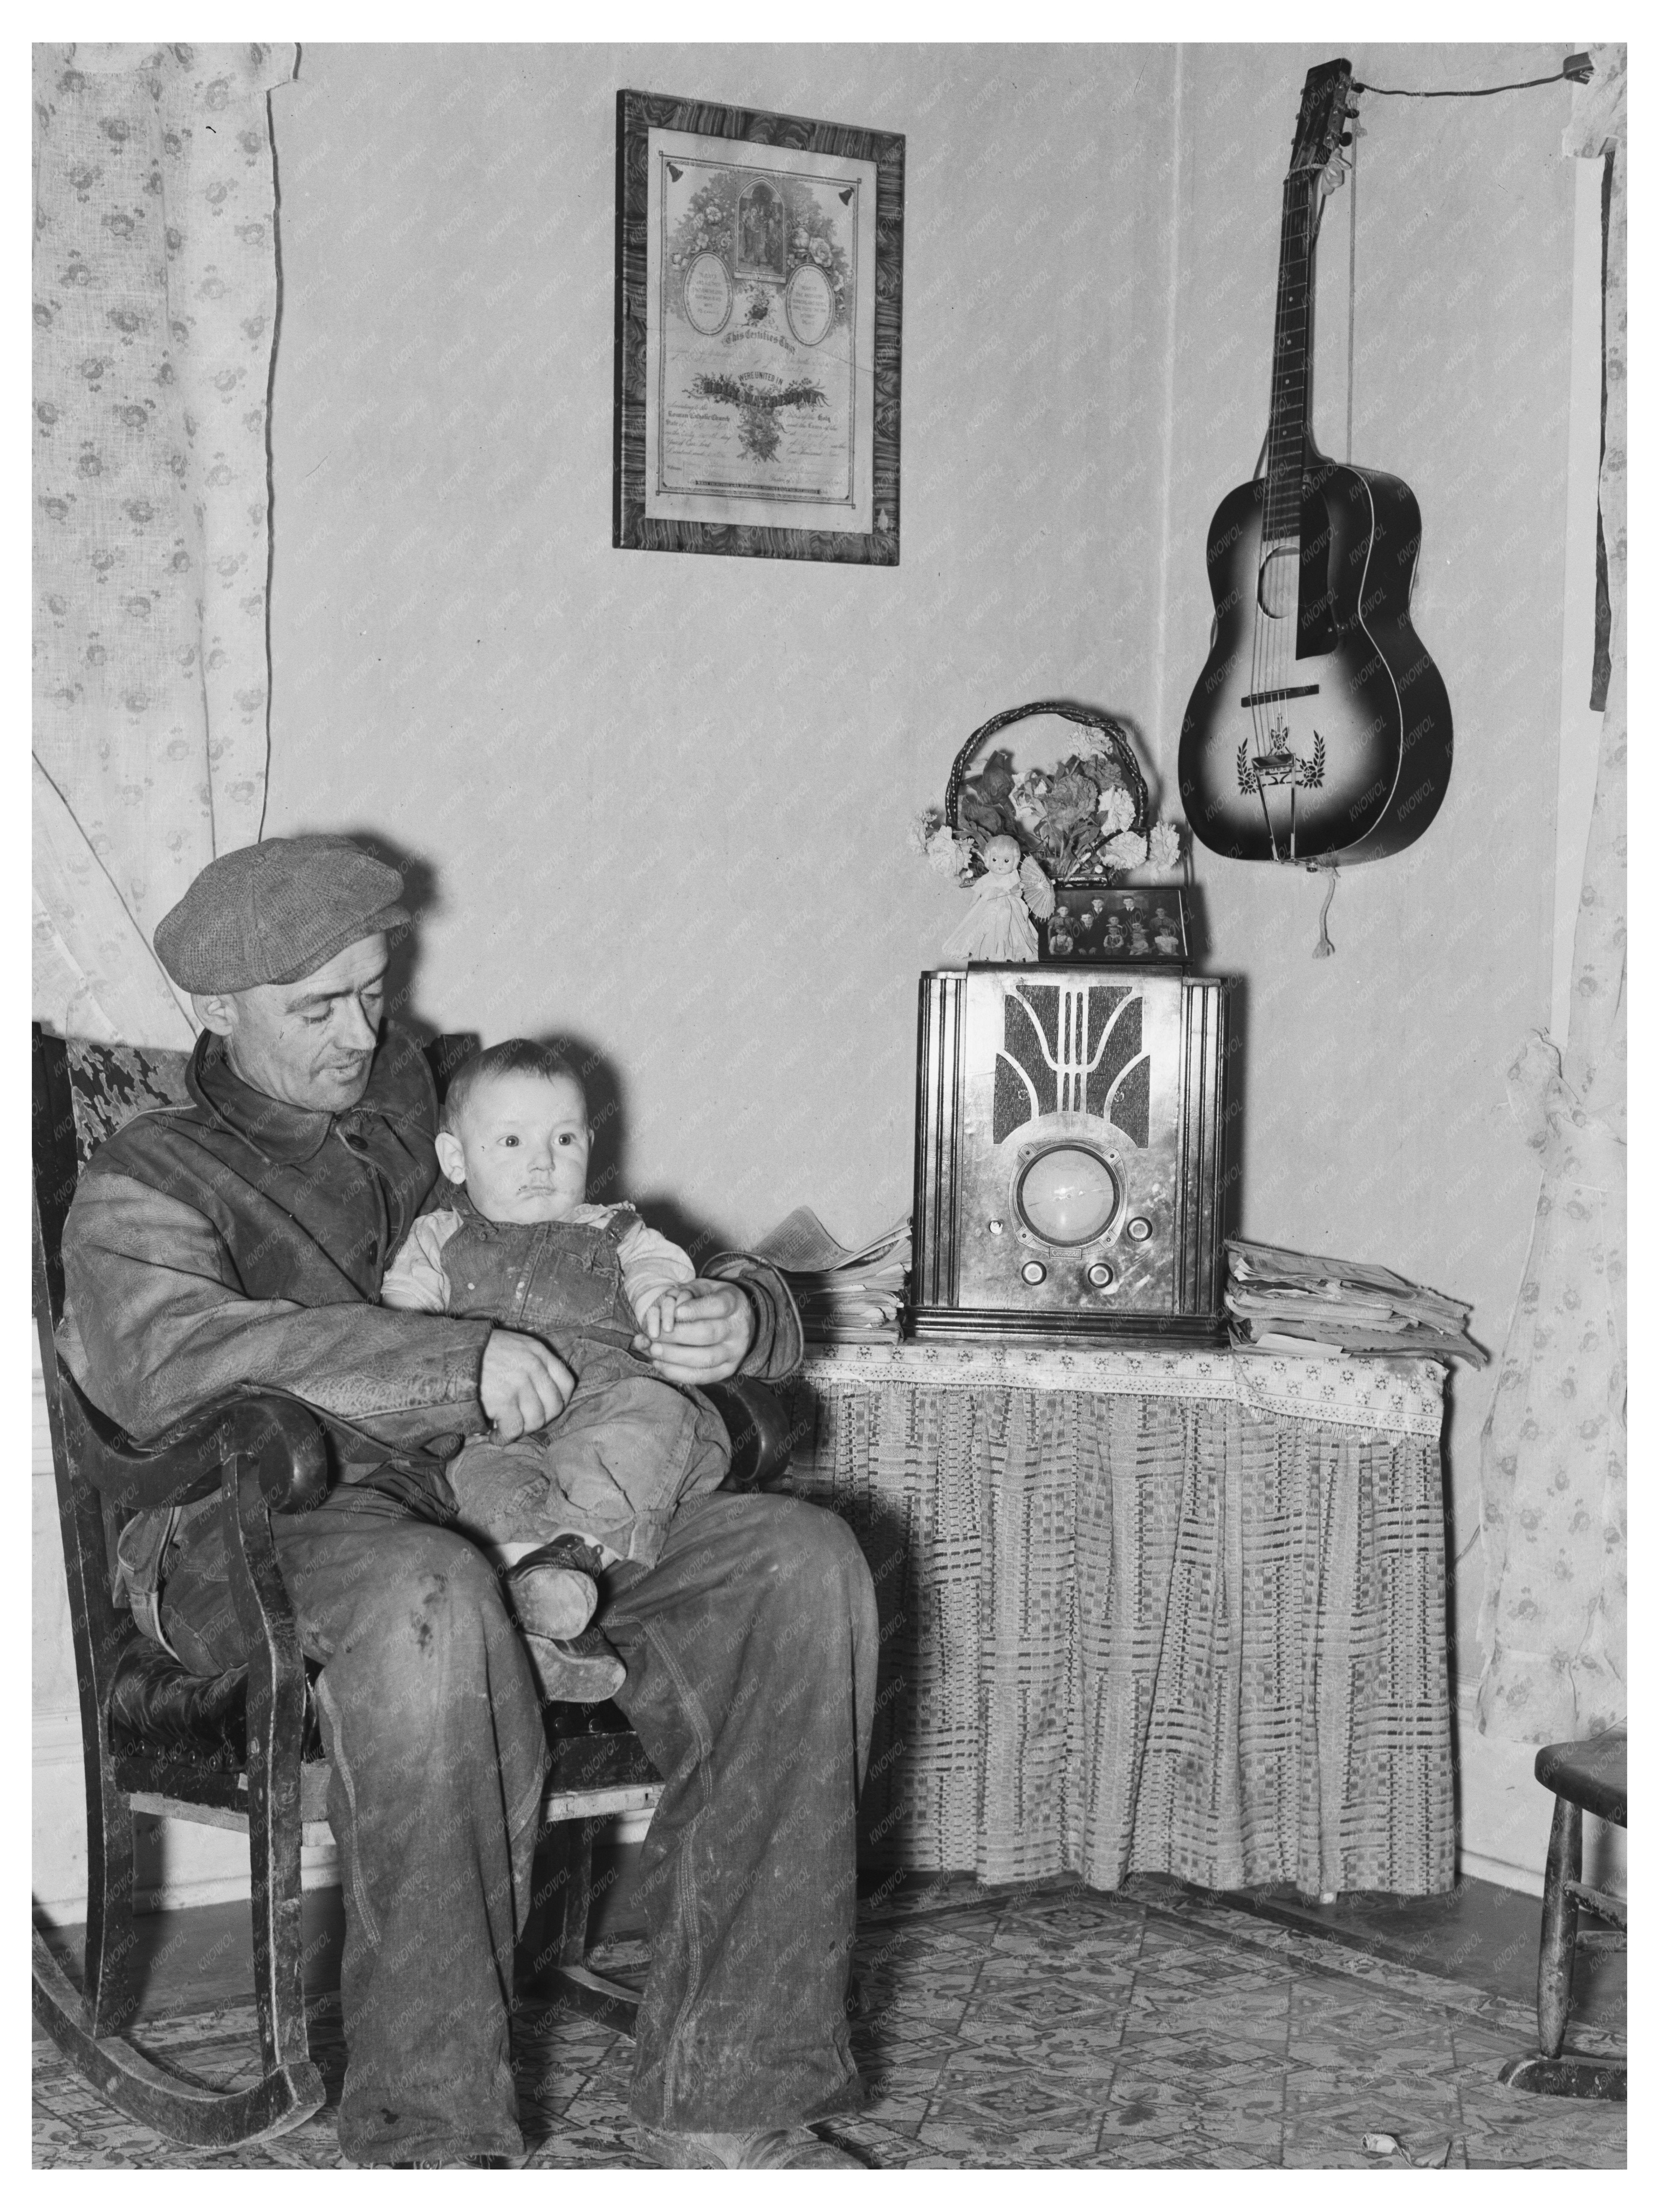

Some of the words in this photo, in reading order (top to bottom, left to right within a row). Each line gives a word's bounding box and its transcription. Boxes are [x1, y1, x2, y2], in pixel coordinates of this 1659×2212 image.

[724, 332, 744, 344] This
[745, 329, 778, 343] Certifies
[738, 372, 755, 382] WERE
[755, 371, 775, 382] UNITED
[775, 375, 784, 385] IN
[704, 381, 740, 400] HOLY
[744, 388, 820, 408] MATRIMONY
[711, 414, 730, 422] Church
[818, 413, 831, 423] Holy
